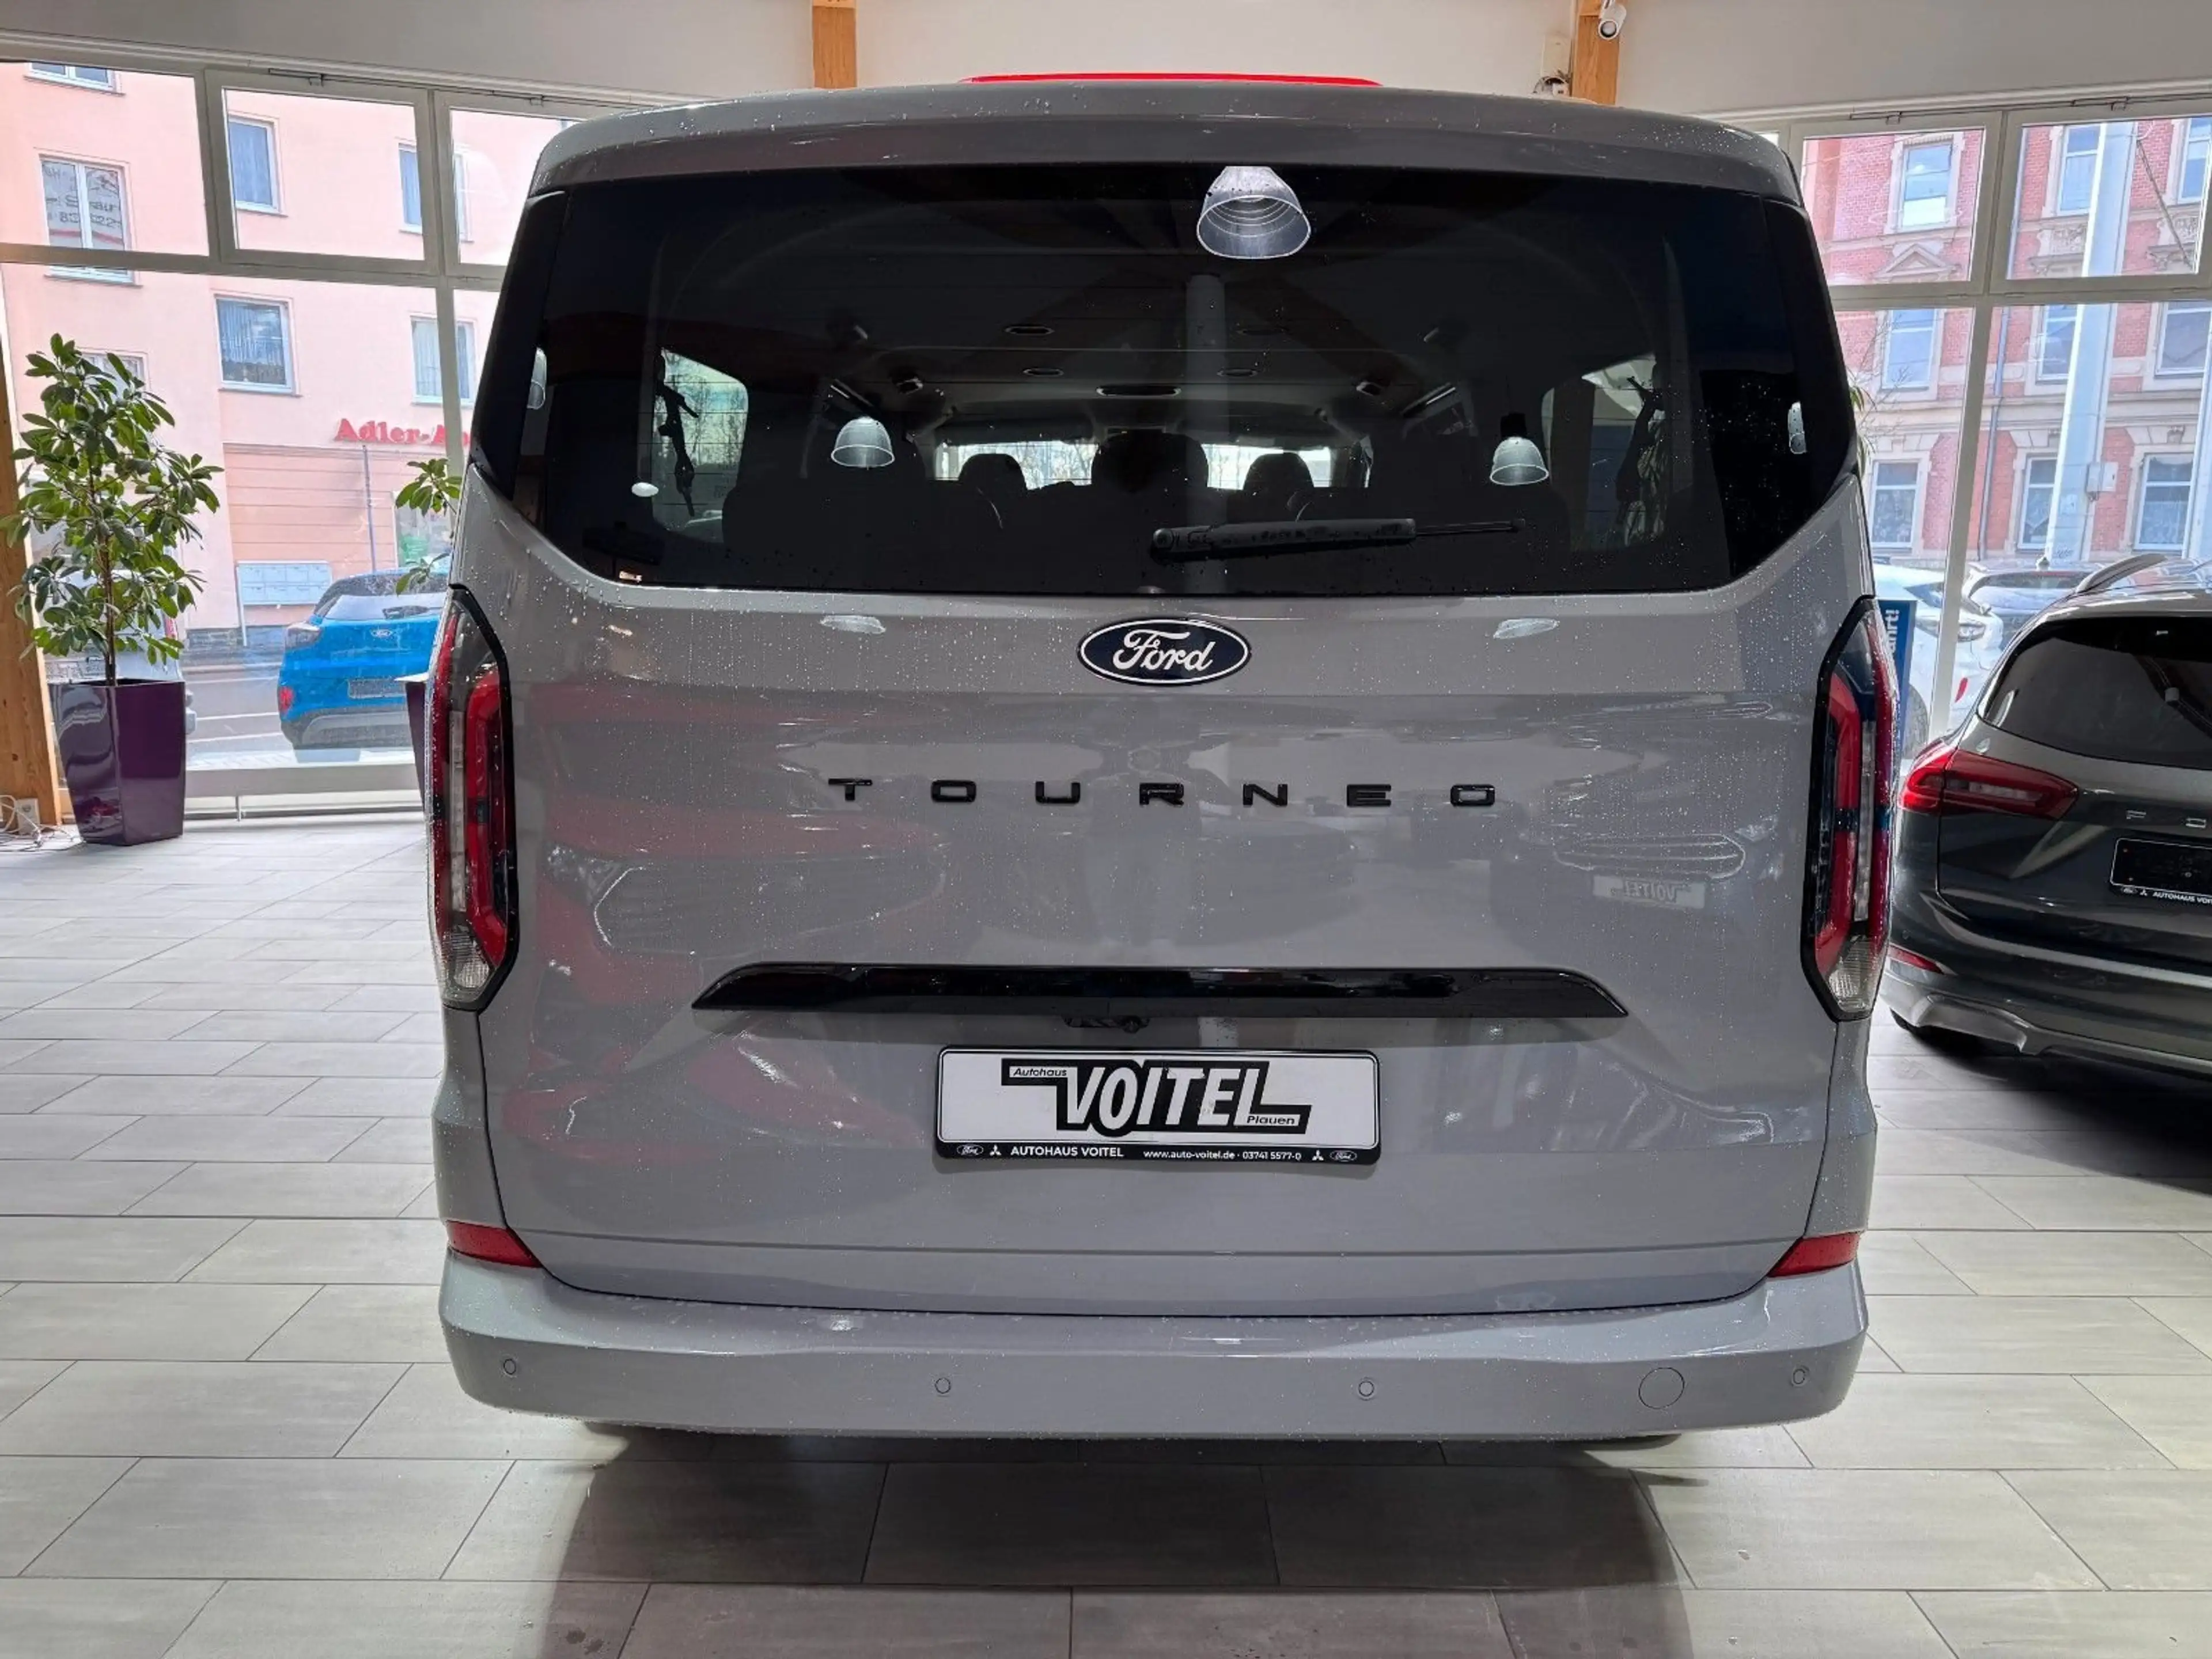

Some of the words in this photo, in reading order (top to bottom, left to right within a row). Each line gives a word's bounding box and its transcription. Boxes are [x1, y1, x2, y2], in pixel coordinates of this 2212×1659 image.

[1113, 629, 1216, 671] Ford
[828, 777, 1495, 807] TOURNEO
[2153, 892, 2195, 902] AUTOHAUS
[1013, 1067, 1067, 1077] Autohaus
[1067, 1066, 1260, 1130] VOITEL
[1247, 1115, 1296, 1125] Plauen
[1011, 1146, 1078, 1157] AUTOHAUS
[1082, 1147, 1124, 1157] VOITEL
[1143, 1150, 1235, 1160] www.auto-voitel.de
[1270, 1152, 1302, 1161] 5577-0
